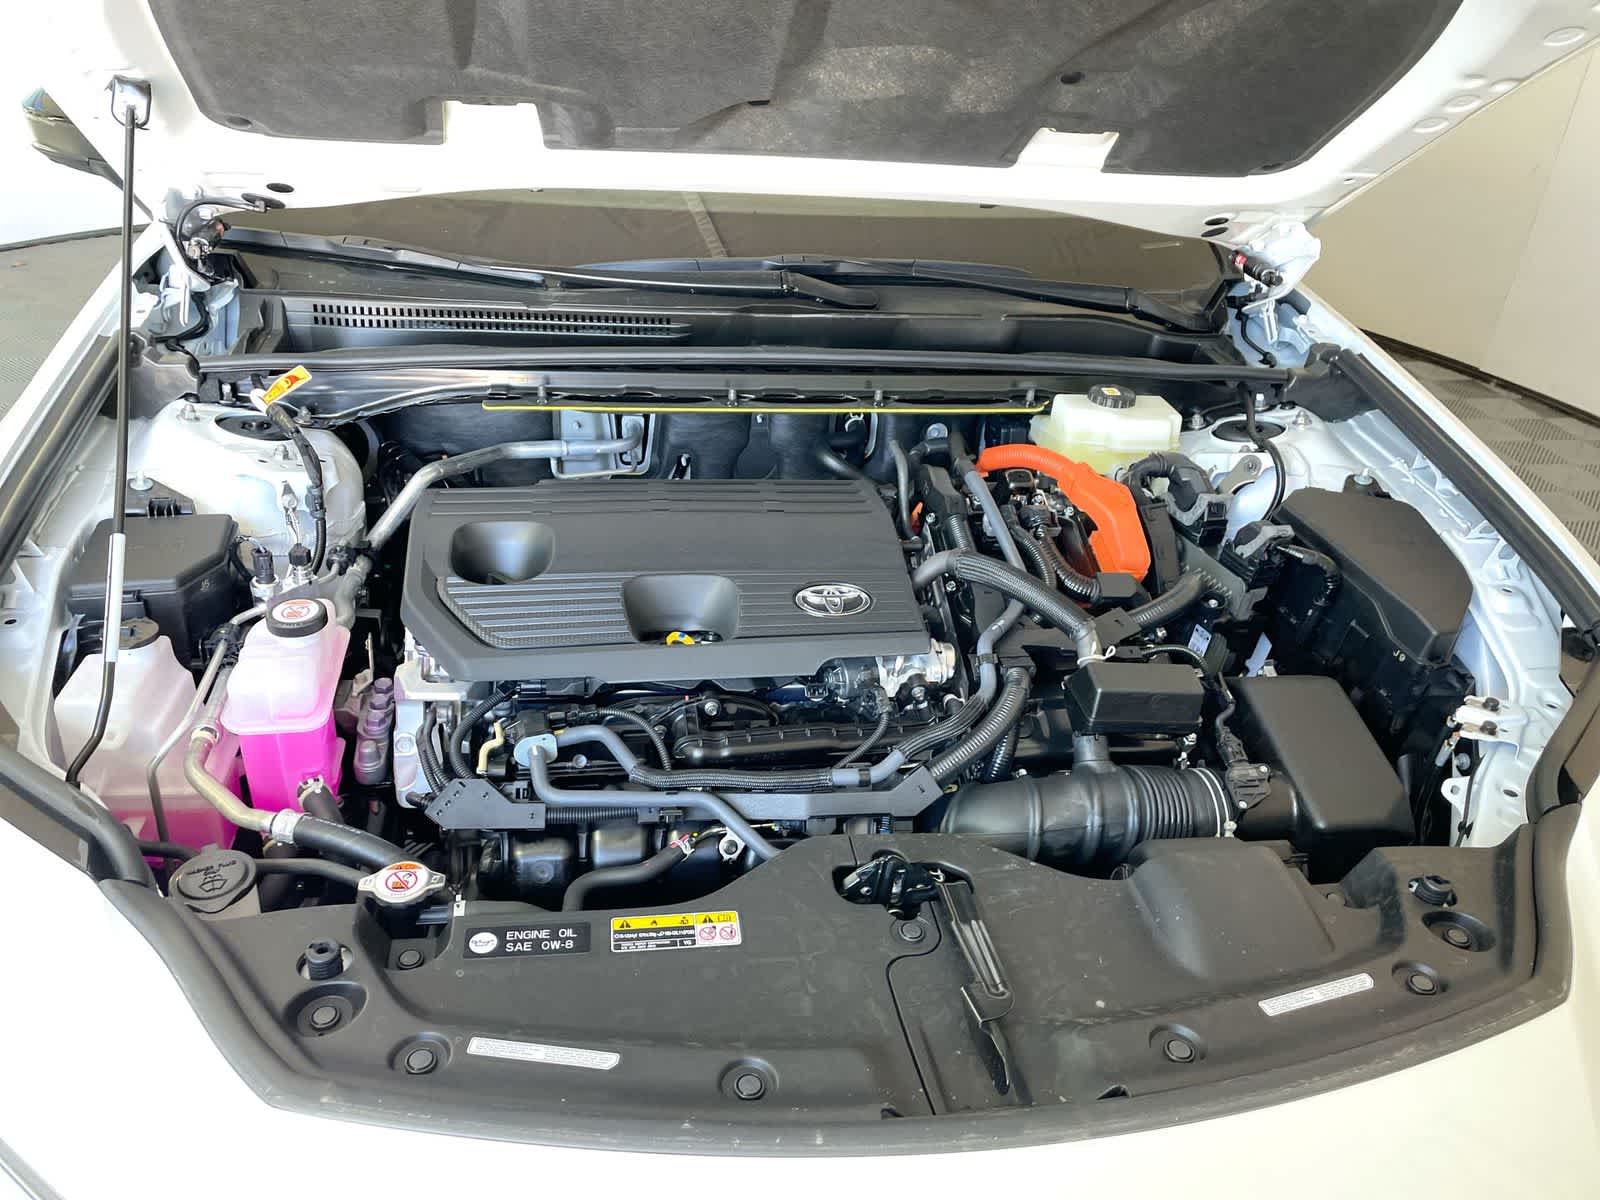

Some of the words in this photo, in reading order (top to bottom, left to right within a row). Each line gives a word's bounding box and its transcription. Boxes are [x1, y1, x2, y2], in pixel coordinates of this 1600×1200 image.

[506, 929, 551, 940] ENGINE
[558, 928, 577, 938] OIL
[505, 941, 533, 952] SAE
